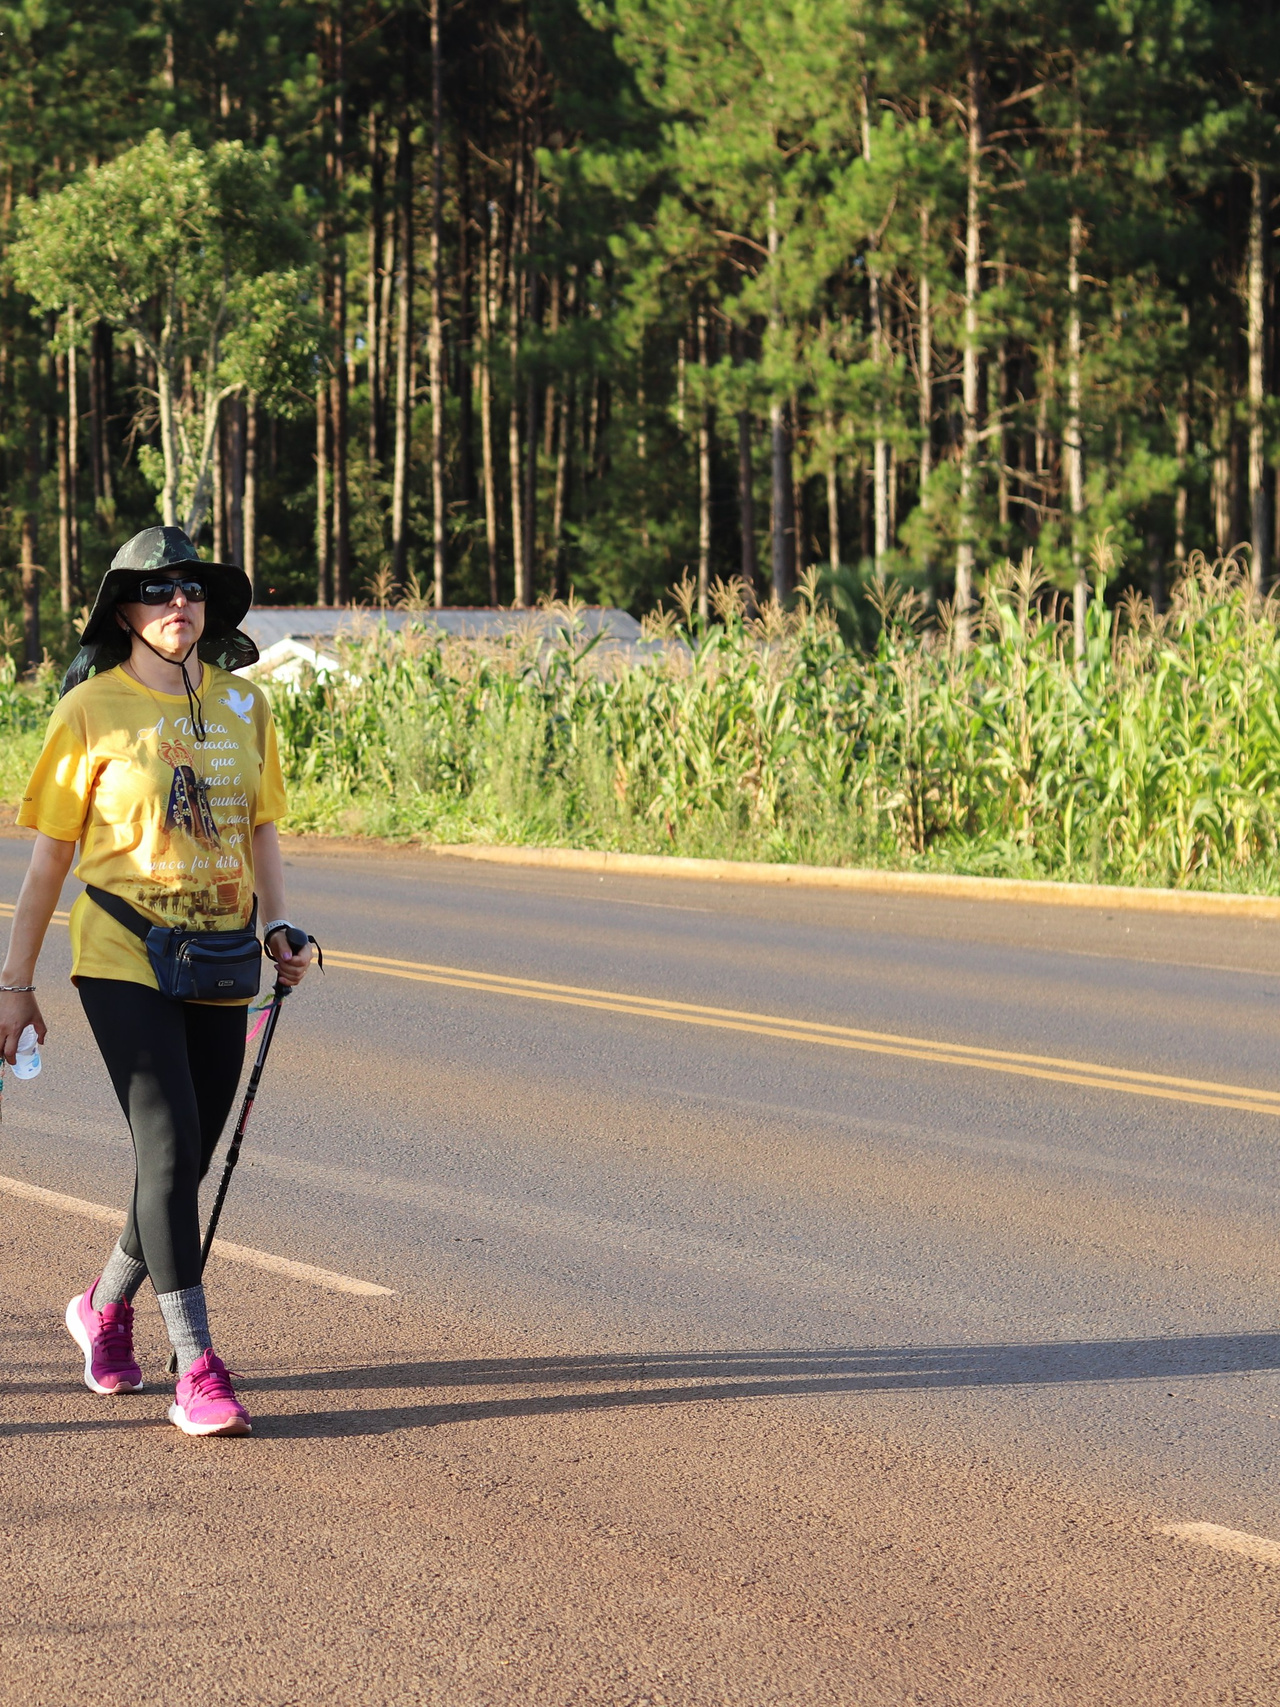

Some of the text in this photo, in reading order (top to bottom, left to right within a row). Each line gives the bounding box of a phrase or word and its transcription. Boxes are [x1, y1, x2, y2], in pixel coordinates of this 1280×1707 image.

[137, 716, 165, 740] A
[194, 738, 239, 751] oração
[211, 757, 236, 771] que
[204, 772, 241, 786] não é
[190, 855, 210, 873] foi
